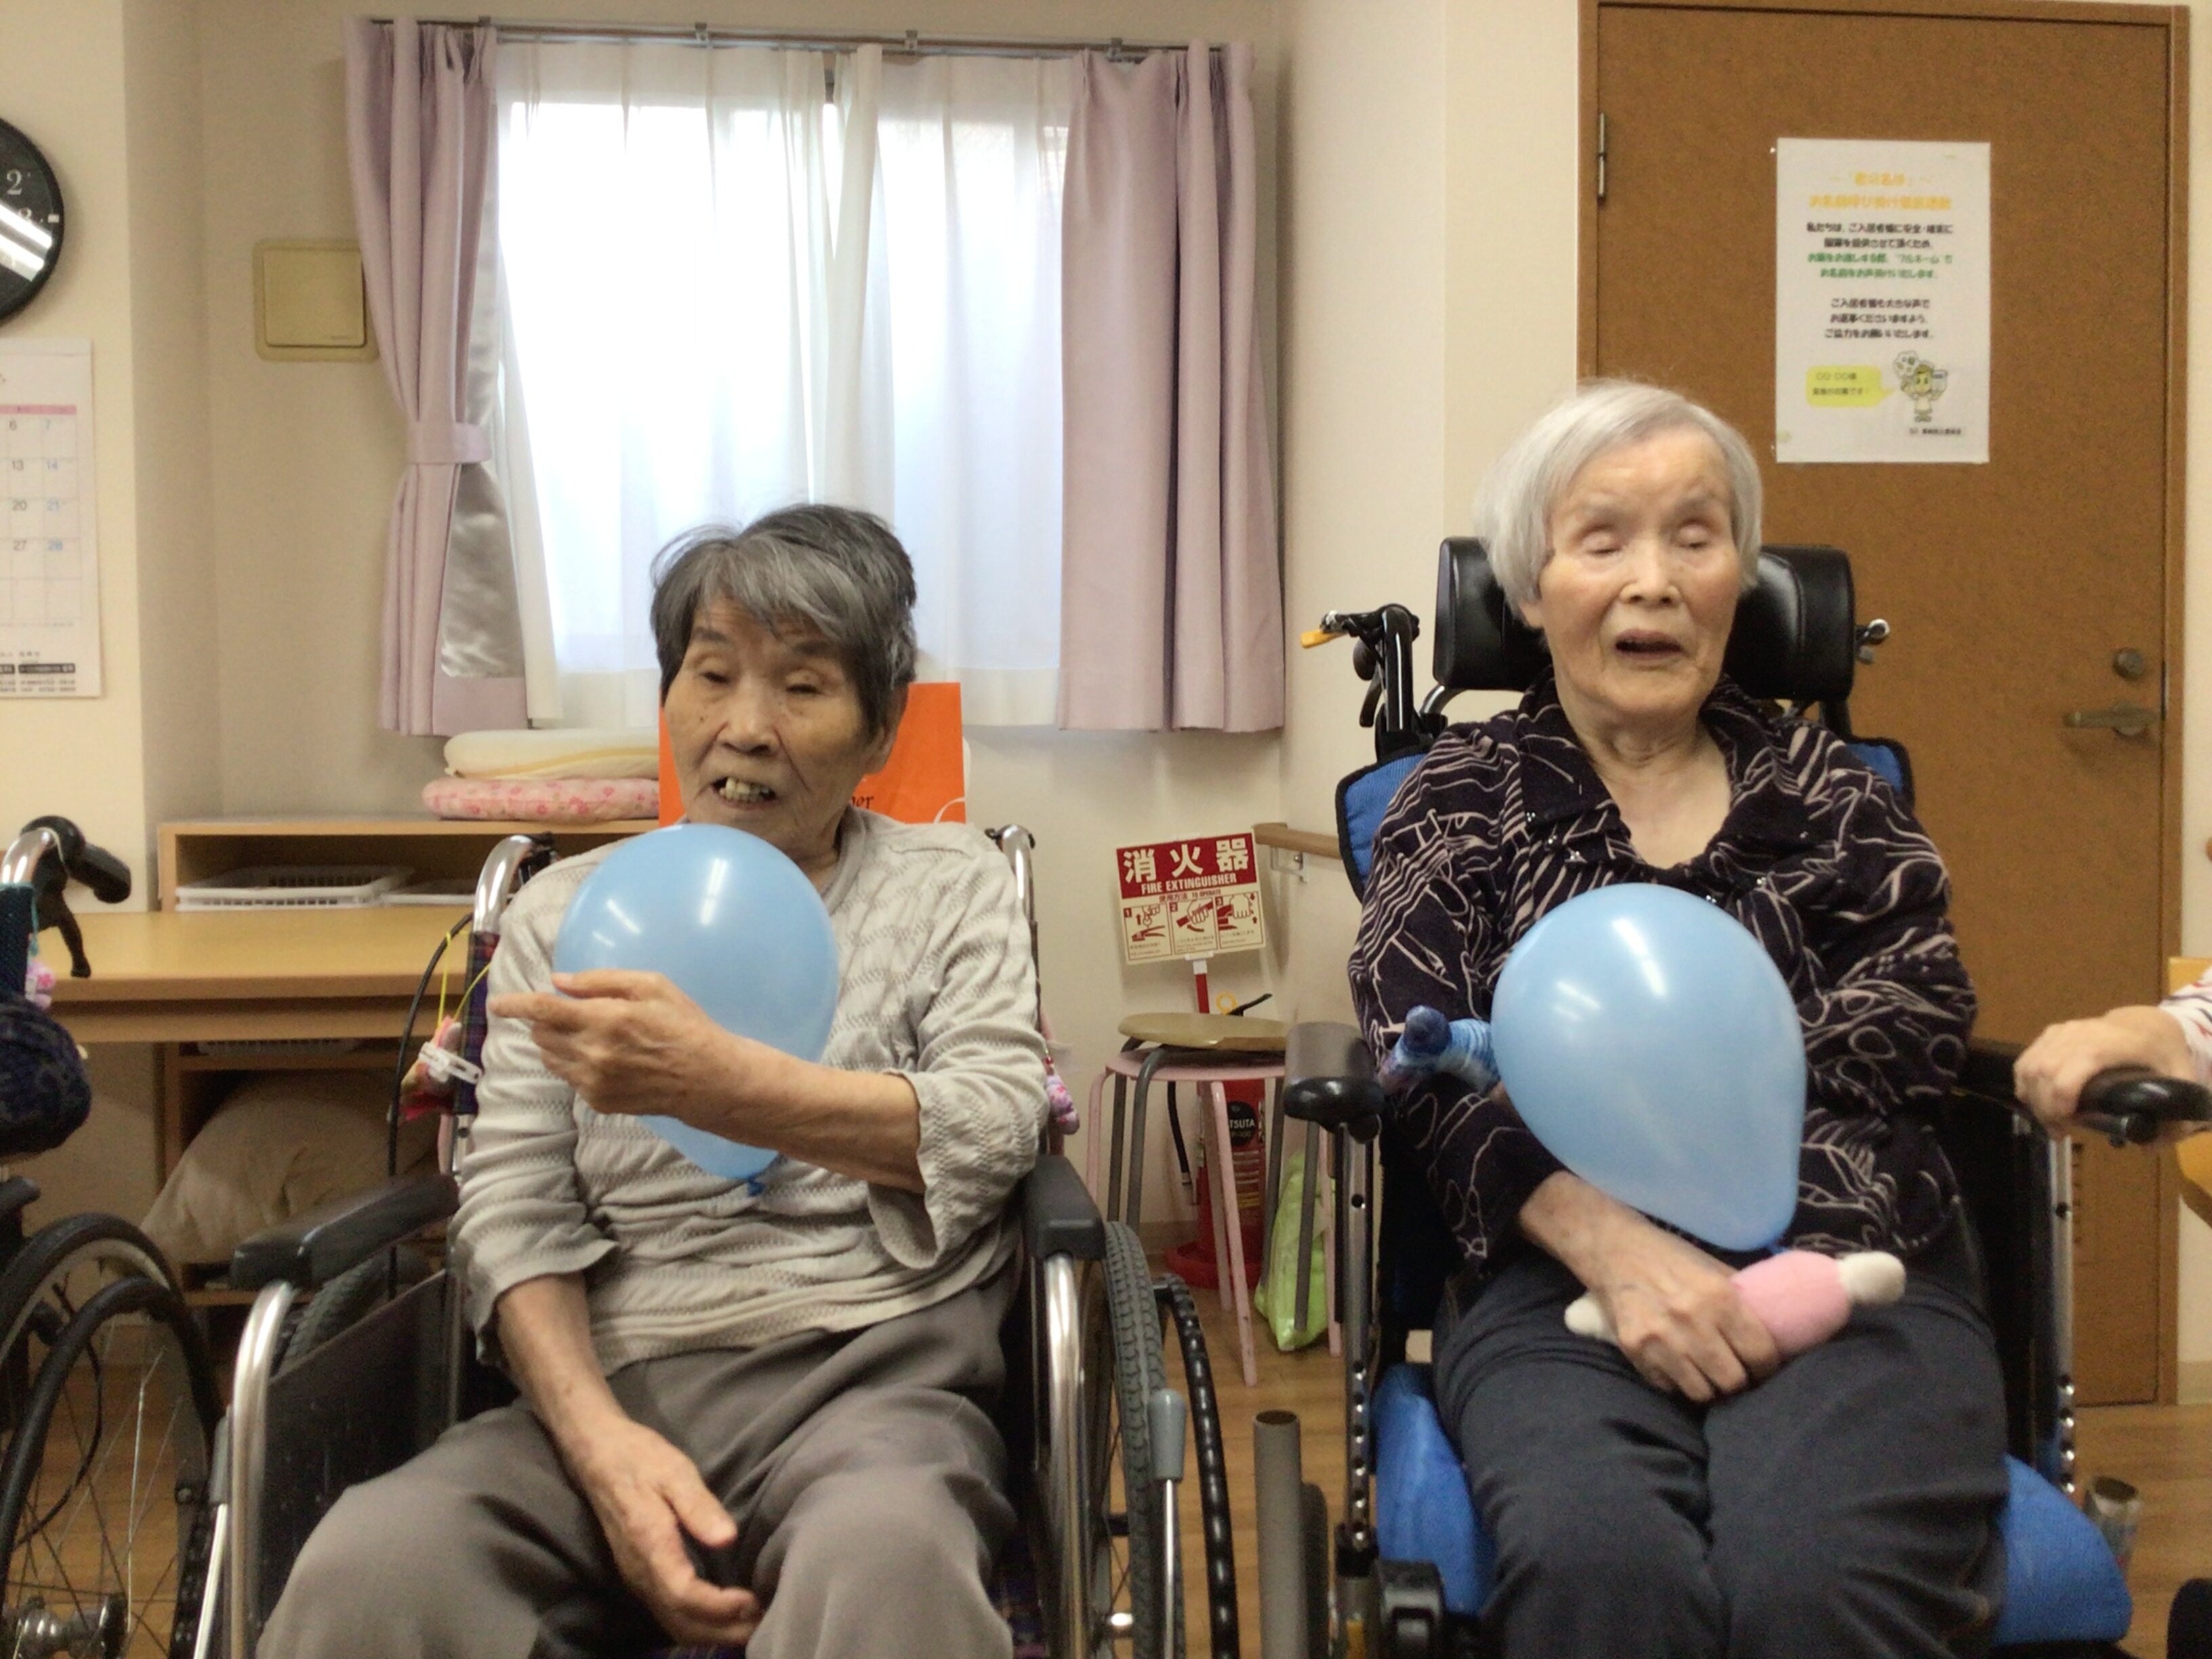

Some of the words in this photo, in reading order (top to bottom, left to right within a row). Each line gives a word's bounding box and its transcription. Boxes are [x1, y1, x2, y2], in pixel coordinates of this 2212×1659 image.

[6, 169, 22, 195] 2
[9, 419, 18, 432] 6
[45, 419, 52, 431] 7
[12, 459, 24, 472] 13
[46, 459, 58, 472] 14
[12, 499, 28, 512] 20
[47, 499, 60, 512] 21
[12, 539, 28, 552] 27
[47, 539, 64, 552] 28
[1124, 838, 1248, 883] 消火器
[1141, 882, 1164, 895] FIRE
[1166, 873, 1237, 891] EXTINGUISHER
[1200, 888, 1221, 897] OPERATE
[1229, 1118, 1255, 1129] TSUTA
